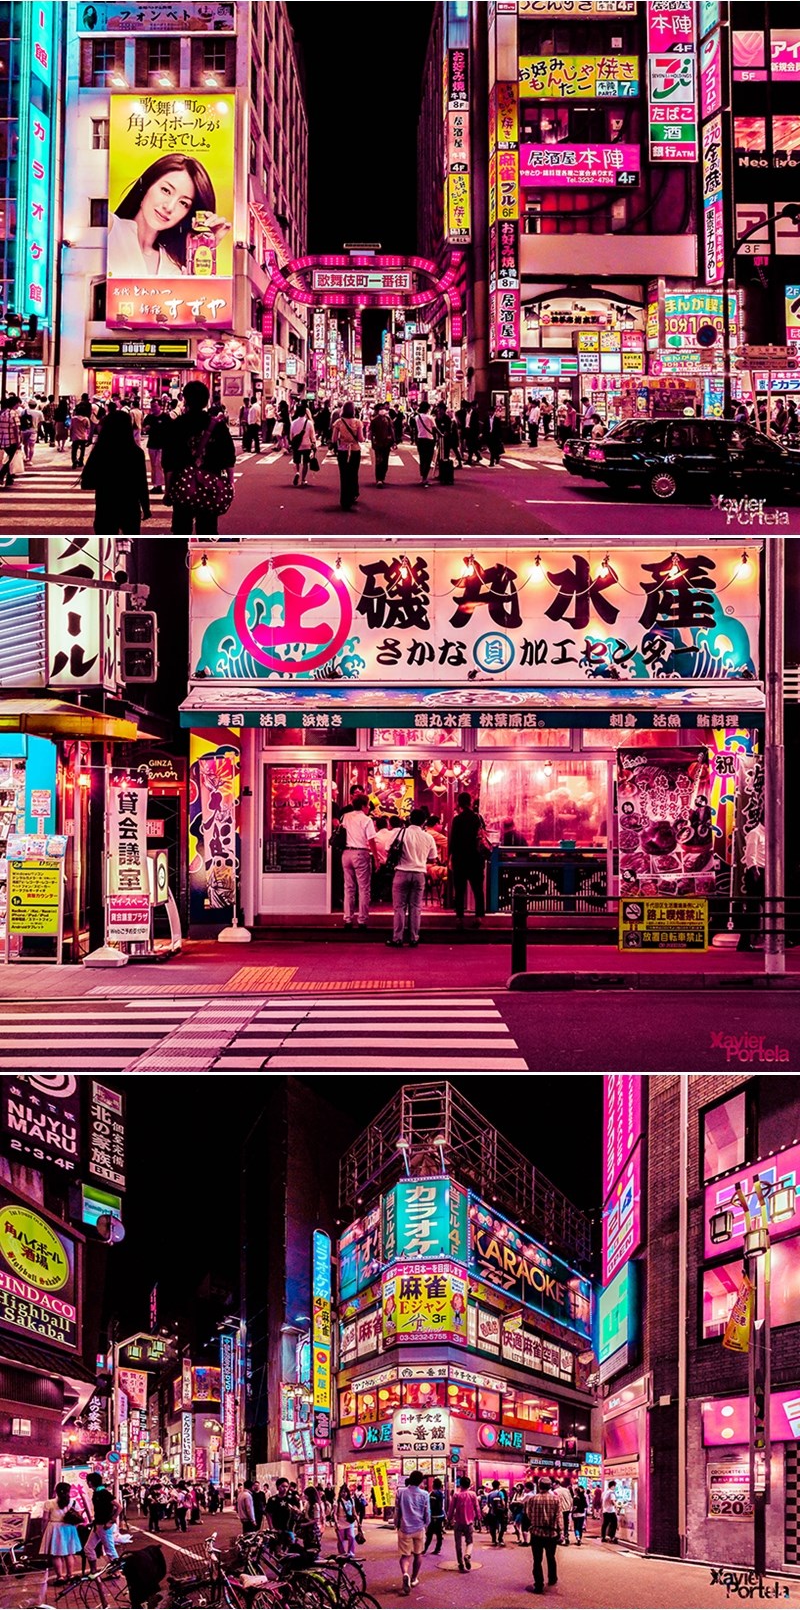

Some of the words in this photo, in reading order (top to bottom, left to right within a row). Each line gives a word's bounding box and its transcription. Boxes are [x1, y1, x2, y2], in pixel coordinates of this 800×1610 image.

[651, 15, 691, 34] 本陣
[673, 43, 692, 52] 4F
[598, 58, 634, 80] 焼き
[741, 72, 755, 80] 5F
[706, 64, 716, 104] アコム
[652, 108, 693, 121] たばこ
[128, 116, 220, 132] 角ハイボールが
[663, 126, 682, 139] 酒
[529, 151, 575, 165] 居酒屋
[652, 147, 694, 158] 銀行ATM
[618, 172, 635, 184] 4F
[29, 120, 46, 301] カラオケ館
[502, 208, 514, 218] 6F
[502, 223, 515, 267] お好み焼
[745, 245, 760, 253] 3F
[317, 274, 408, 288] 歌舞伎町一番街
[164, 298, 227, 320] すずや
[356, 552, 716, 630] 磯丸水産
[520, 638, 701, 665] 加工センター
[218, 714, 244, 726] 寿司
[302, 714, 342, 727] 浜焼き
[415, 714, 471, 727] 磯丸水産
[480, 714, 537, 727] 秋葉原店
[609, 714, 638, 727] 刺身
[653, 714, 681, 727] 活魚
[716, 756, 735, 774] 祝
[118, 792, 140, 890] 貸会議室
[647, 910, 704, 920] 路上喫煙禁止
[643, 933, 703, 942] 放置自転車禁止
[8, 1099, 77, 1140] NIJYU
[404, 1186, 439, 1256] カラオケ
[21, 1246, 49, 1271] 酒場
[470, 1229, 565, 1306] KARAOKE
[399, 1276, 447, 1299] 麻雀
[400, 1301, 446, 1314] Eジャン
[4, 1309, 65, 1342] Sakaba
[432, 1314, 446, 1323] 3F
